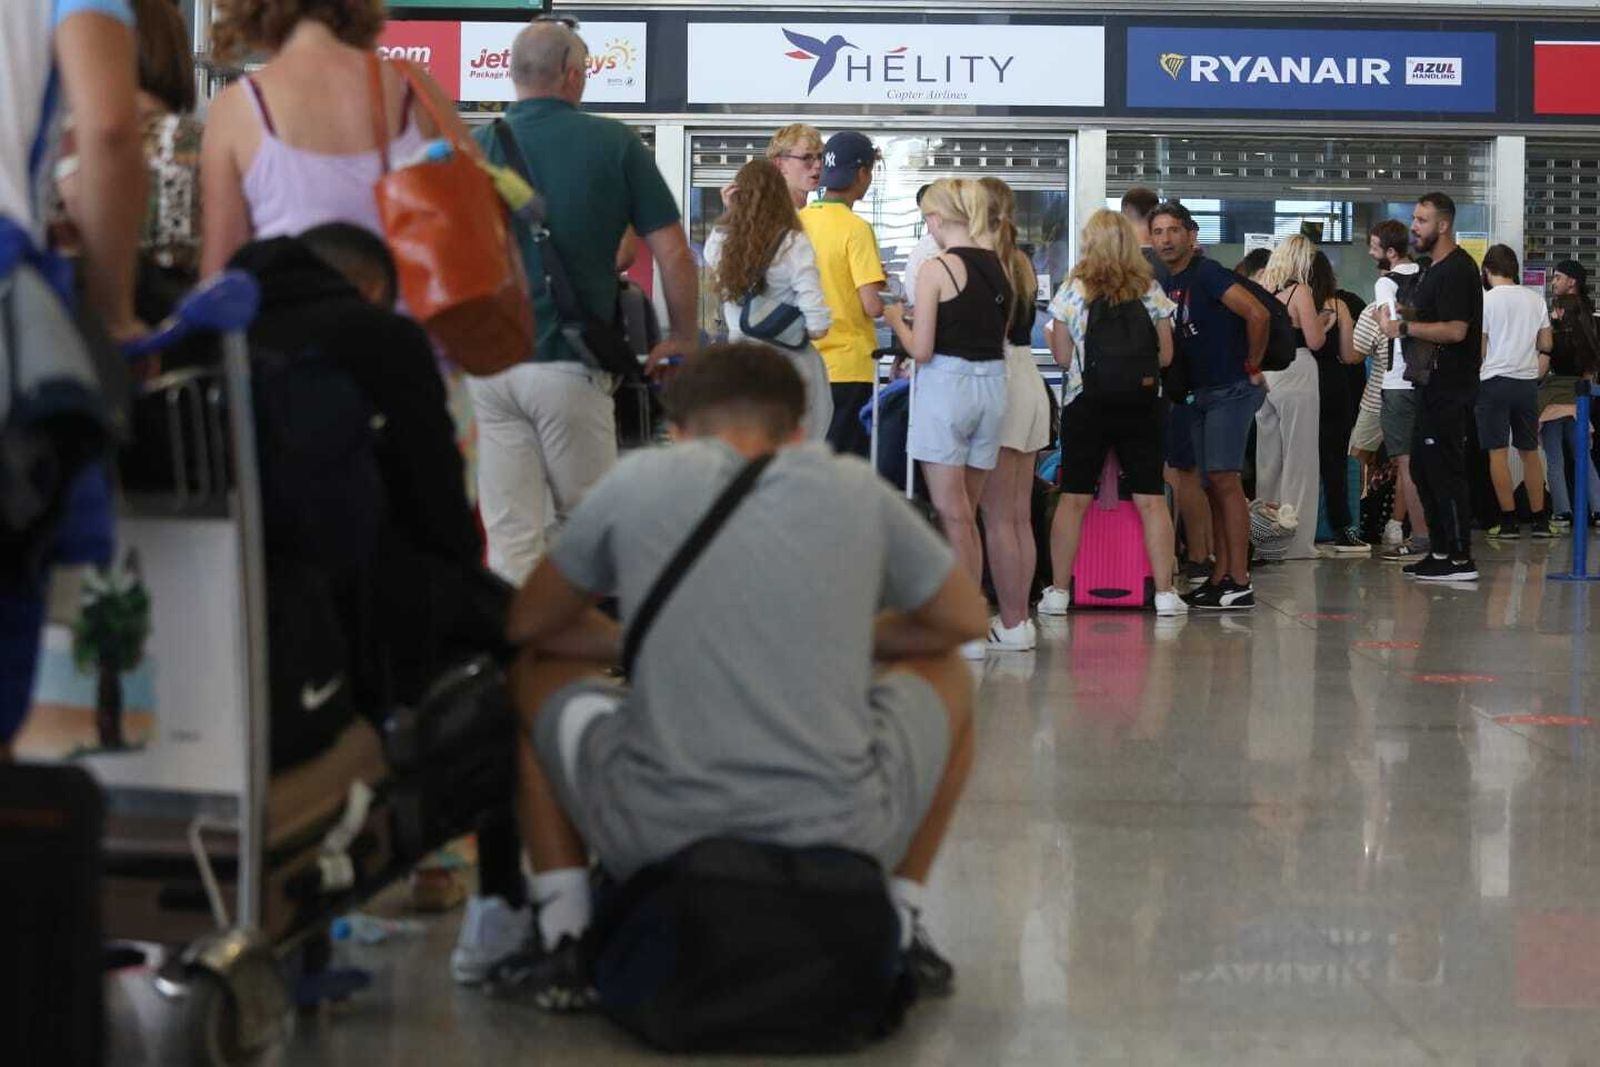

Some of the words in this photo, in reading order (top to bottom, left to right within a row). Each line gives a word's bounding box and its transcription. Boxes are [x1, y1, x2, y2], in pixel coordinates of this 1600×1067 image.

[847, 46, 1014, 83] HÉLITY
[1190, 54, 1391, 85] RYANAIR
[1413, 62, 1456, 73] AZUL
[886, 89, 924, 101] Copter
[926, 88, 968, 100] Airlines
